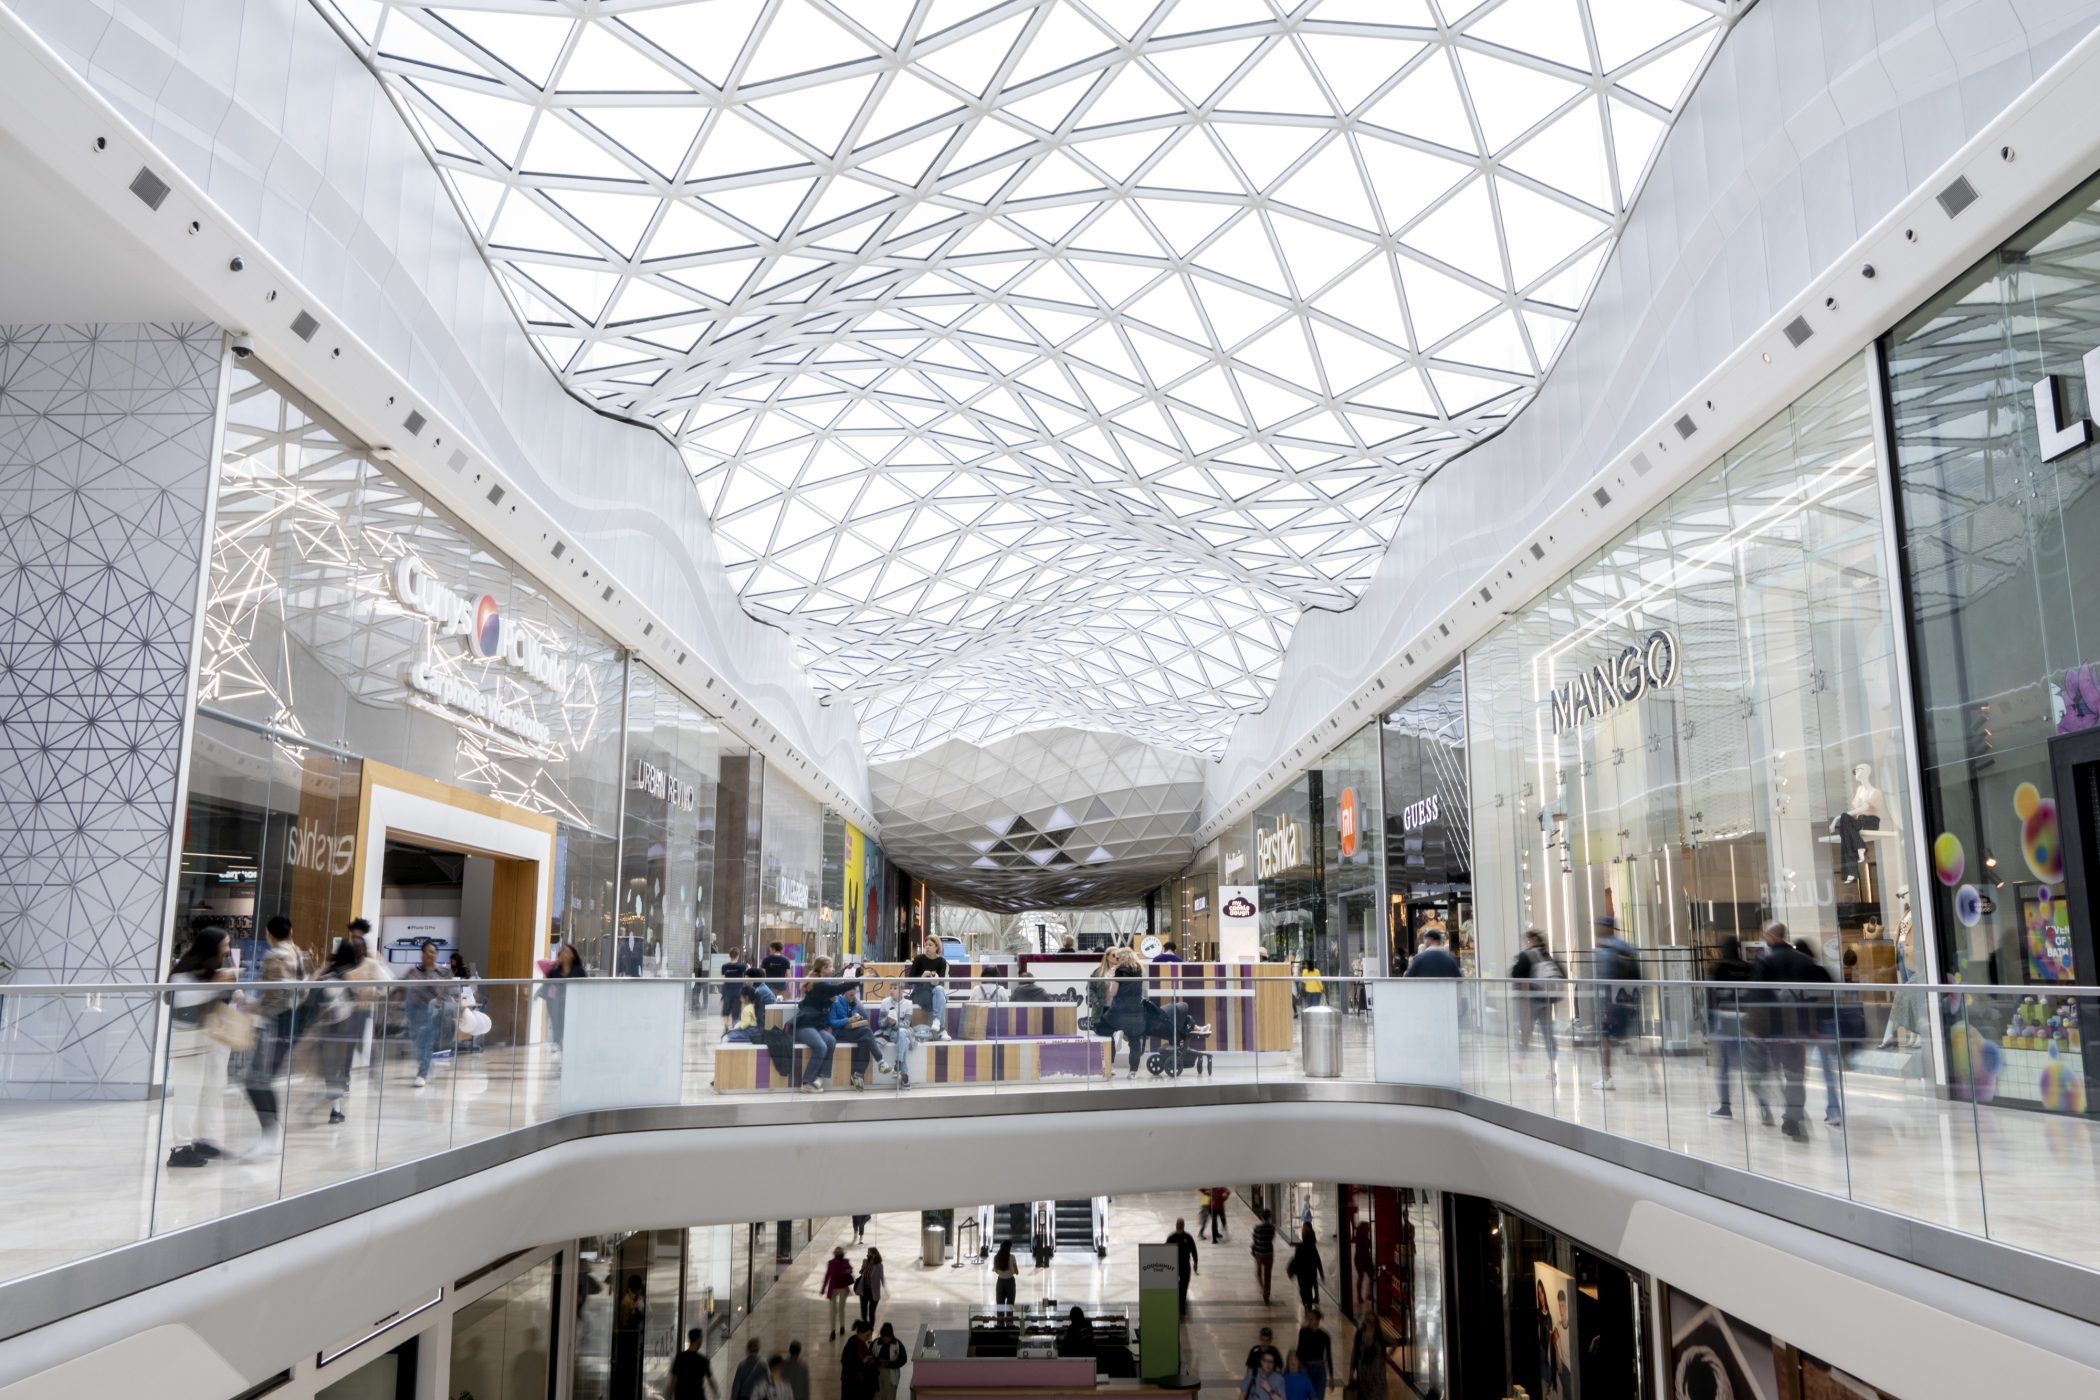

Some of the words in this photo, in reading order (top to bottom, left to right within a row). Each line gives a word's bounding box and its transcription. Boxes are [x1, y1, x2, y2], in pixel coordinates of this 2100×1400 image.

[396, 556, 473, 635] Currys
[497, 615, 526, 667] PC
[524, 635, 567, 693] World
[1551, 630, 1677, 734] MANGO
[411, 662, 486, 716] Carphone
[487, 696, 550, 745] Warehouse
[638, 759, 667, 800] URBAN
[1404, 795, 1438, 831] GUESS
[1257, 813, 1298, 880] Bershka
[2047, 948, 2069, 957] BATH
[2055, 937, 2066, 945] OF
[1143, 1263, 1175, 1271] DOUGHNUT
